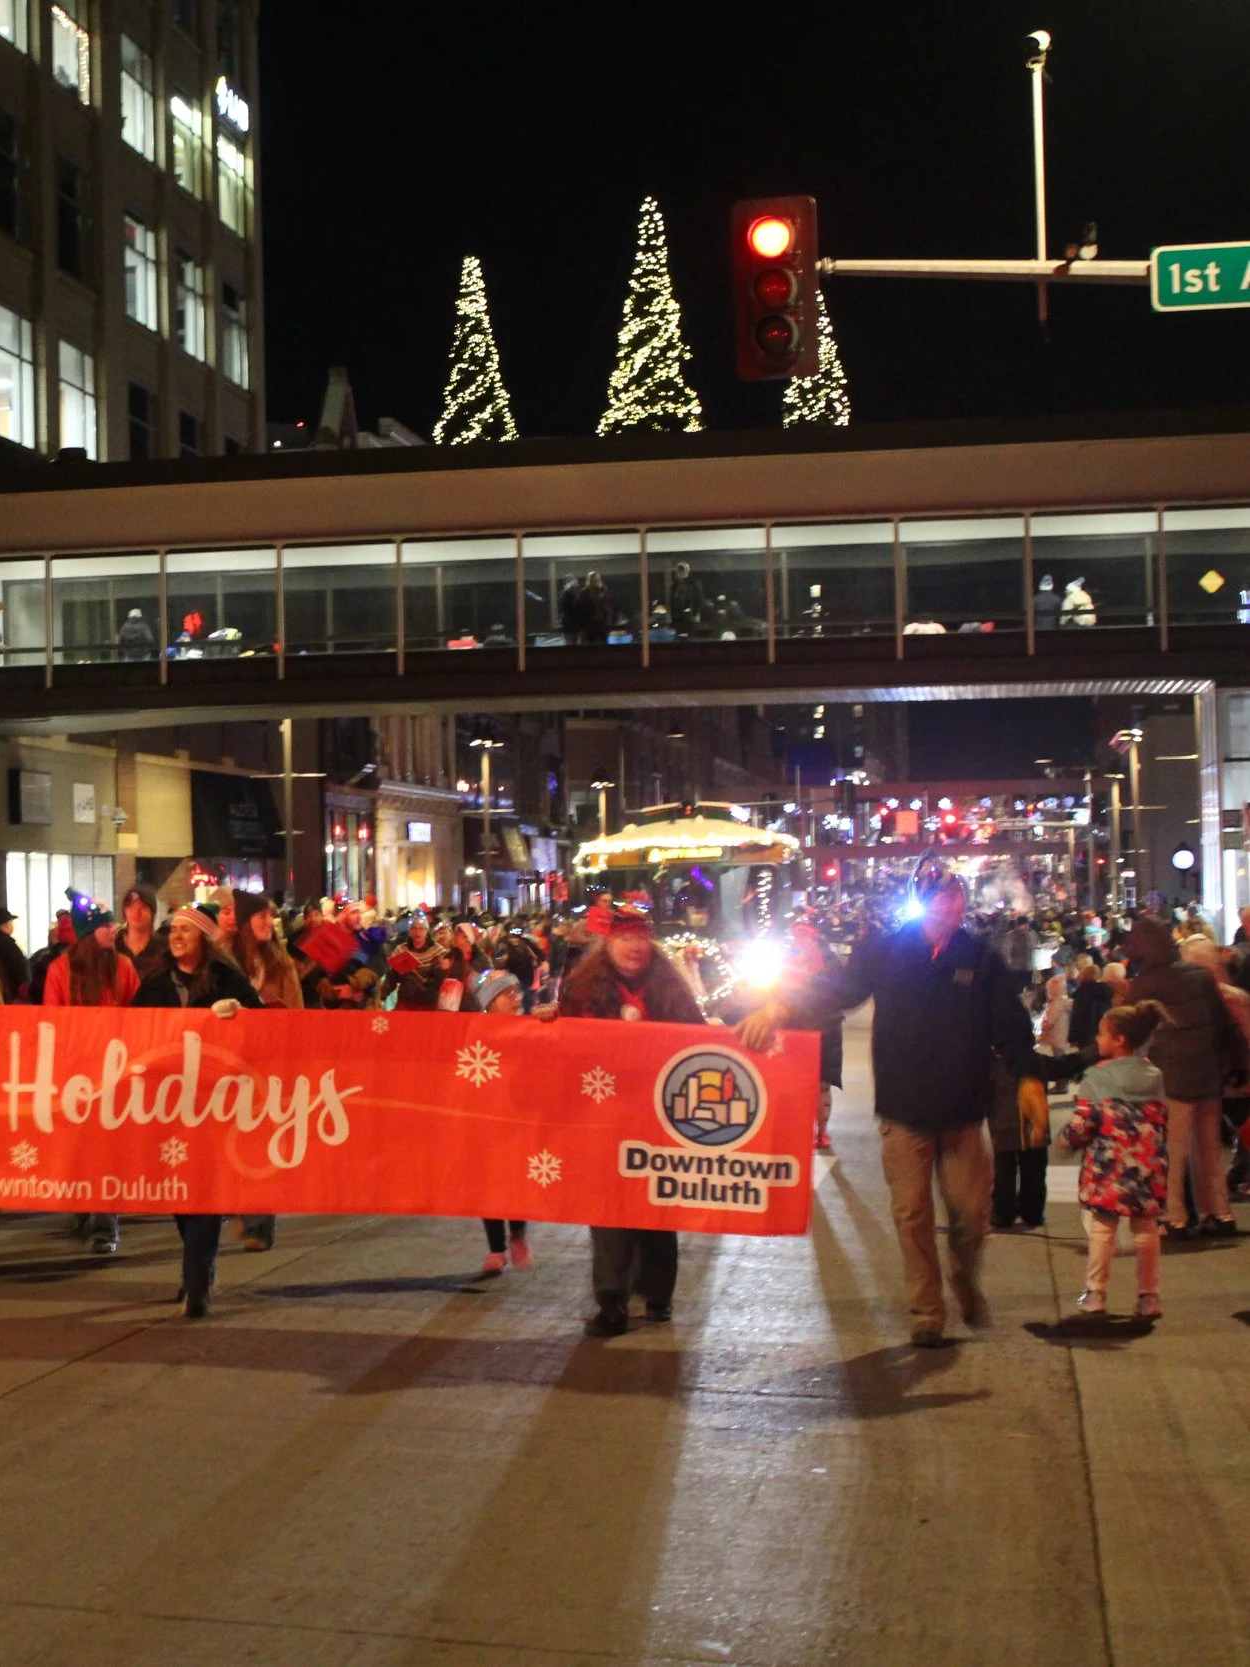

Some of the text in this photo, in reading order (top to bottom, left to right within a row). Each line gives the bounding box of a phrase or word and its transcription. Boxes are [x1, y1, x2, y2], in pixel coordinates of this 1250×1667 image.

[1168, 261, 1221, 294] 1st
[2, 1022, 364, 1169] Holidays
[626, 1147, 792, 1180] Downtown
[102, 1174, 188, 1202] Duluth
[657, 1175, 761, 1206] Duluth
